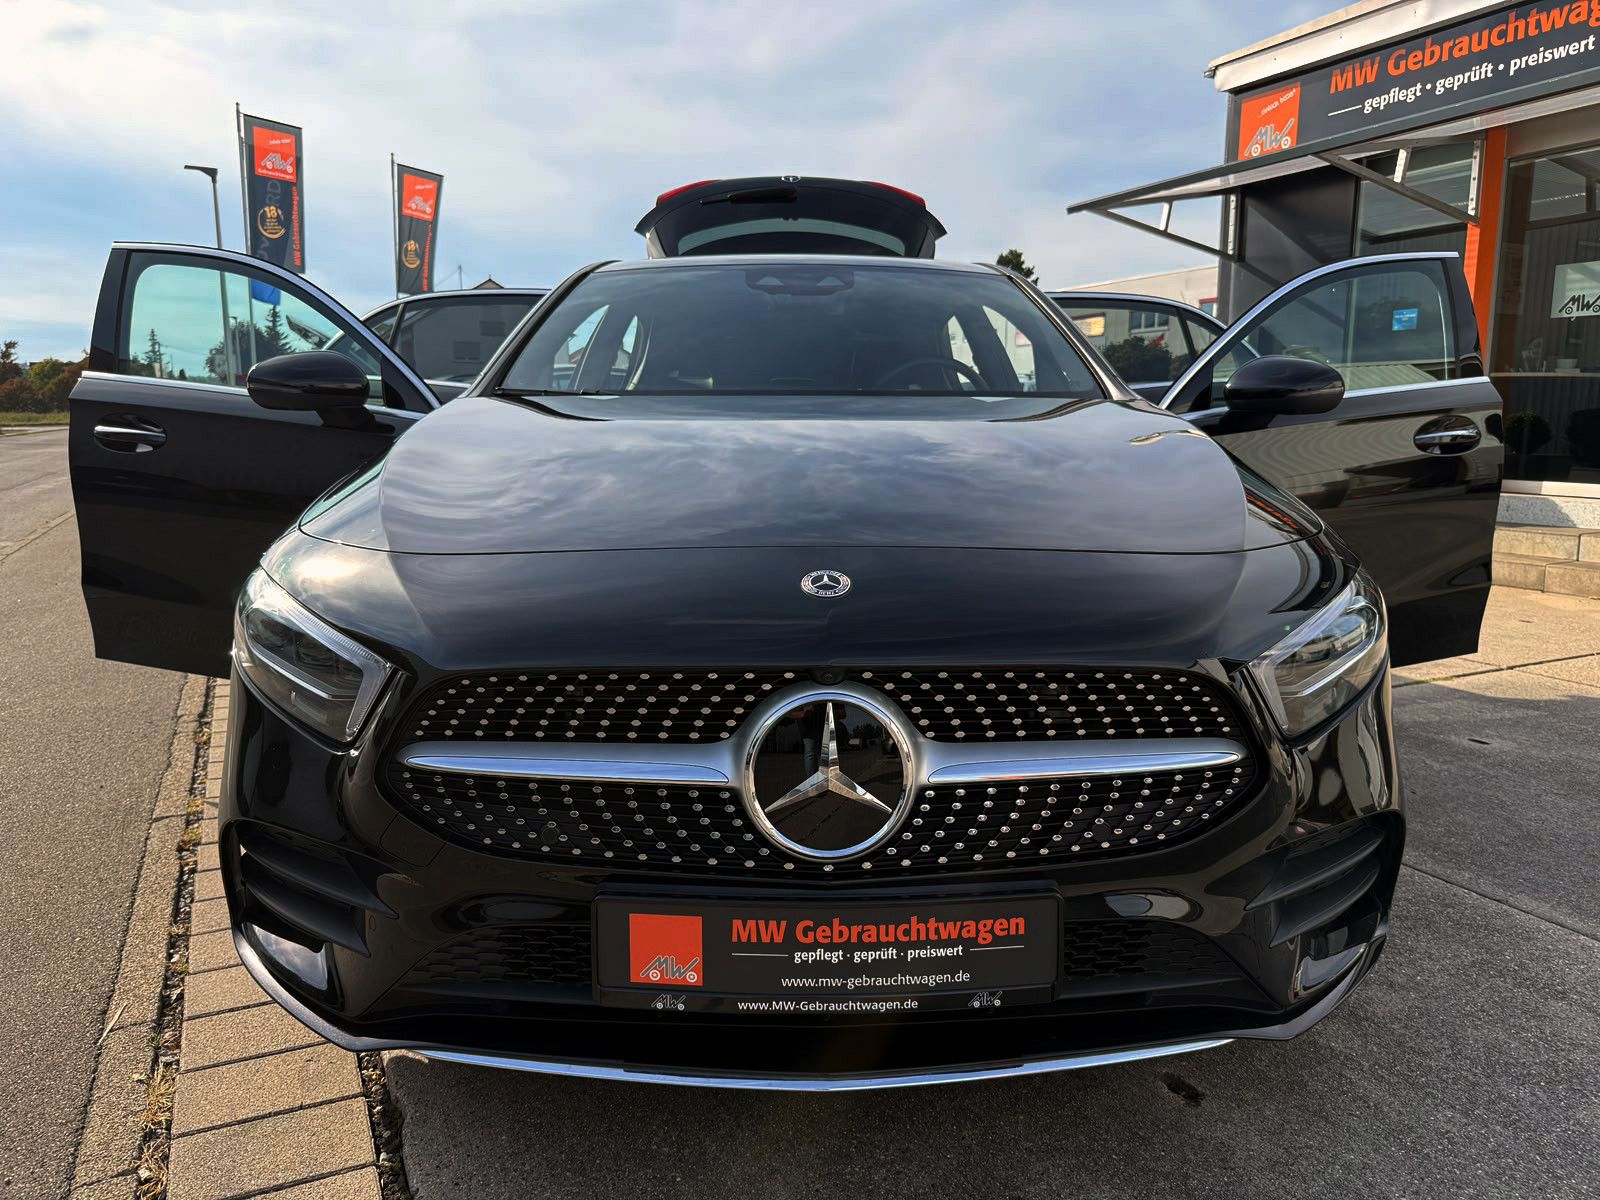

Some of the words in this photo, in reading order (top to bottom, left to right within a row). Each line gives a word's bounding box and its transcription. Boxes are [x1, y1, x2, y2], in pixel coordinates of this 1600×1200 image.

[1329, 56, 1380, 94] MW
[1363, 82, 1422, 114] gepflegt
[1435, 62, 1494, 95] geprüft
[1509, 34, 1596, 76] preiswert
[731, 919, 788, 943] MW
[795, 915, 1025, 945] Gebrauchtwagen
[794, 948, 844, 964] gepflegt
[853, 946, 898, 963] geprüft
[907, 944, 963, 962] preiswert
[640, 955, 700, 983] MW
[781, 969, 971, 990] www.mw-gebrauchtwagen.de
[737, 998, 919, 1012] www.MW-Gebrauchtwagen.de
